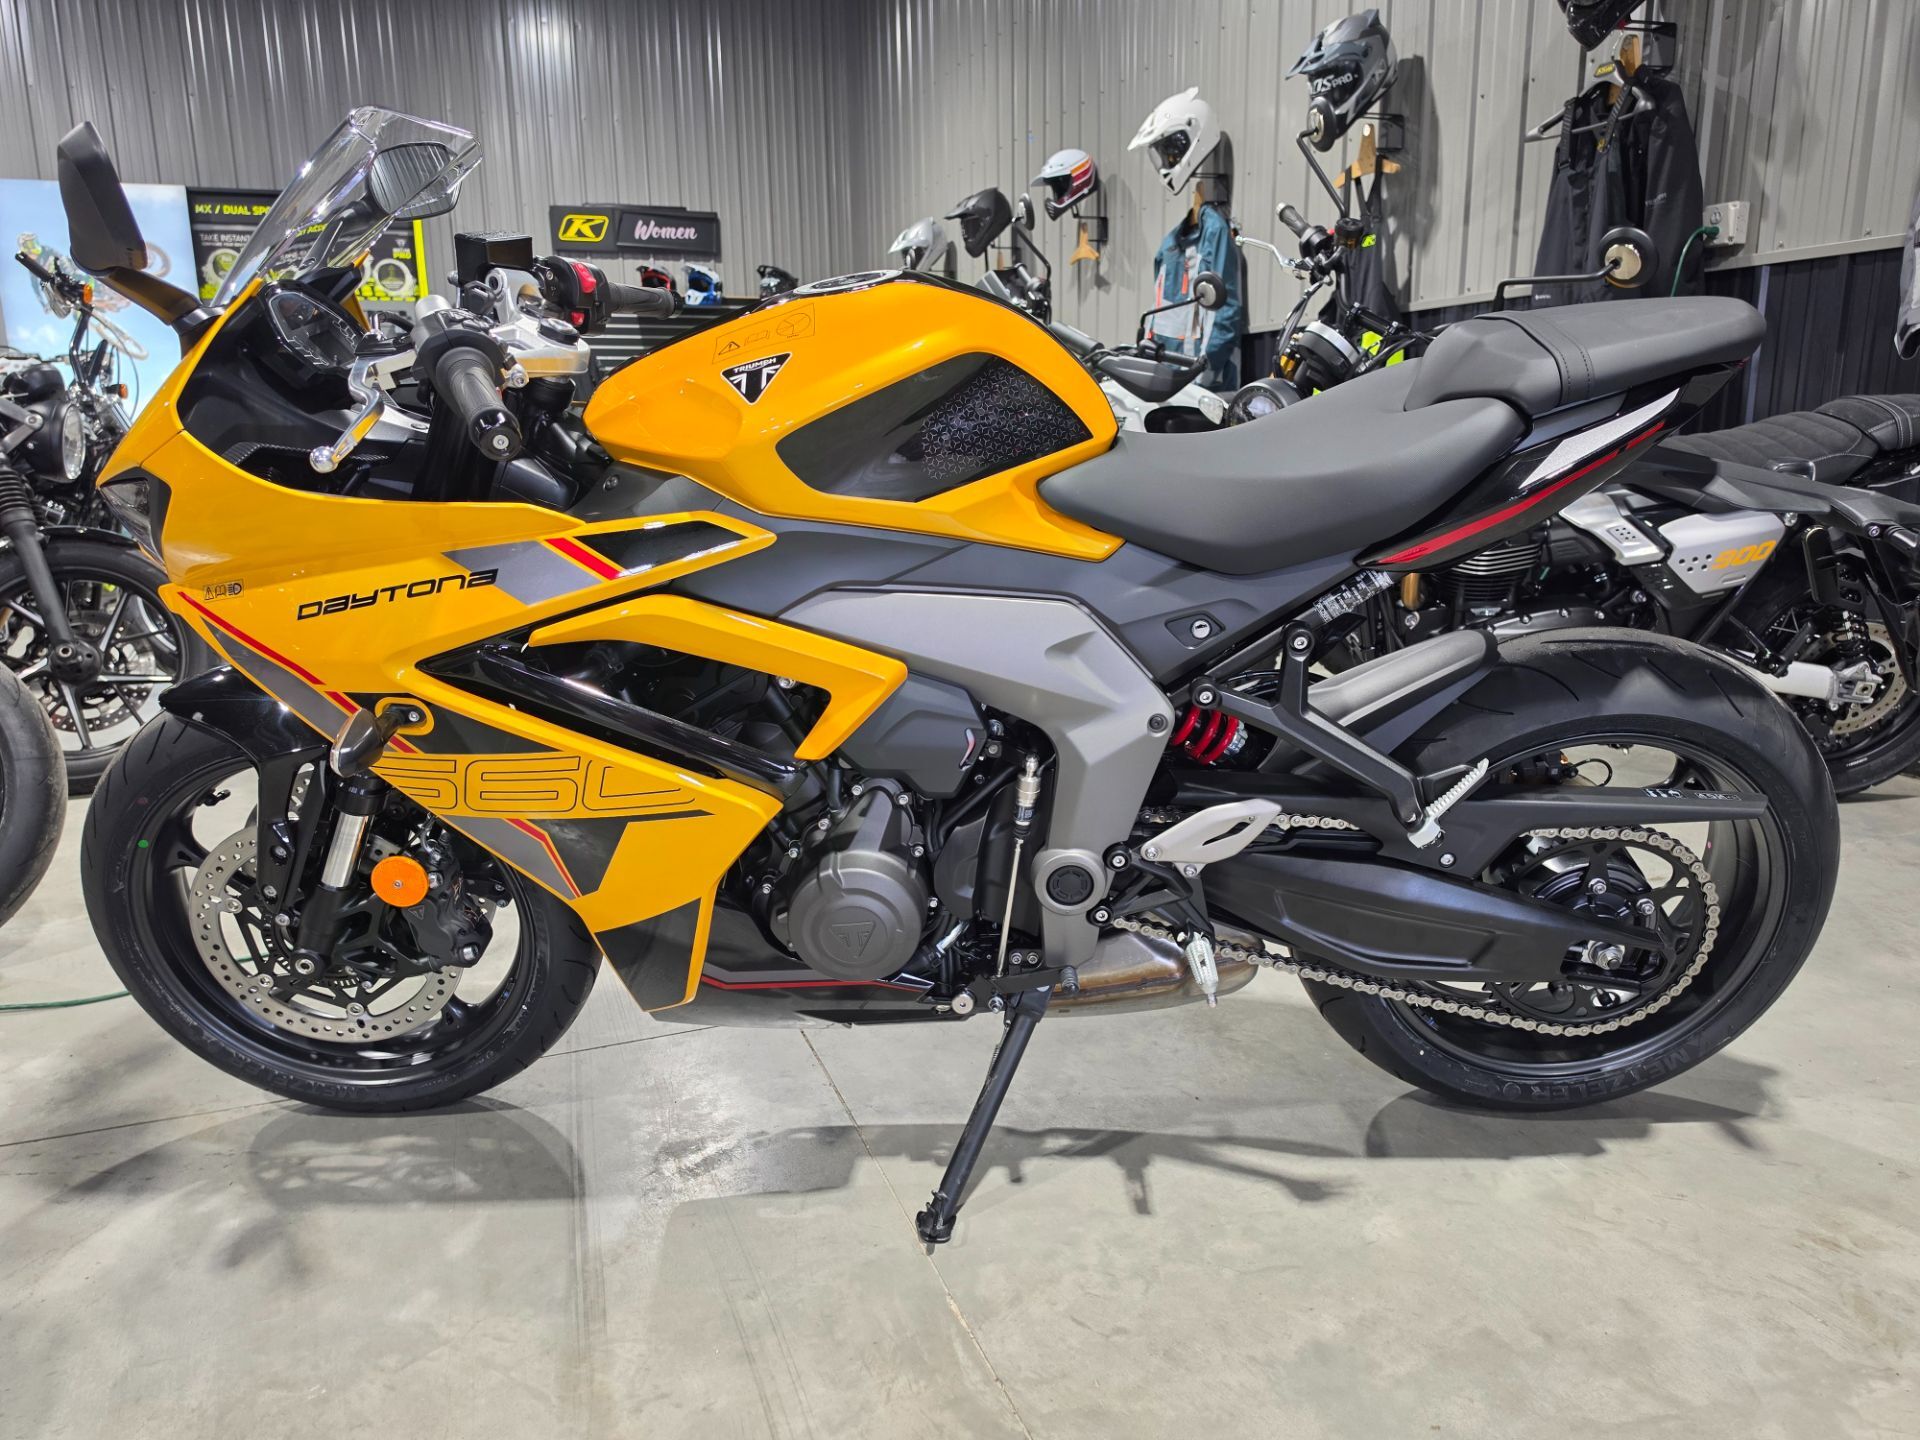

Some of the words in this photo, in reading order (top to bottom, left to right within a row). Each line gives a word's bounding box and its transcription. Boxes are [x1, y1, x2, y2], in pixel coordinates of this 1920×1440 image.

[195, 204, 212, 215] MX
[222, 205, 252, 216] DUAL
[633, 218, 698, 242] Women
[732, 357, 778, 374] TRIUMPH
[1710, 539, 1778, 571] 900
